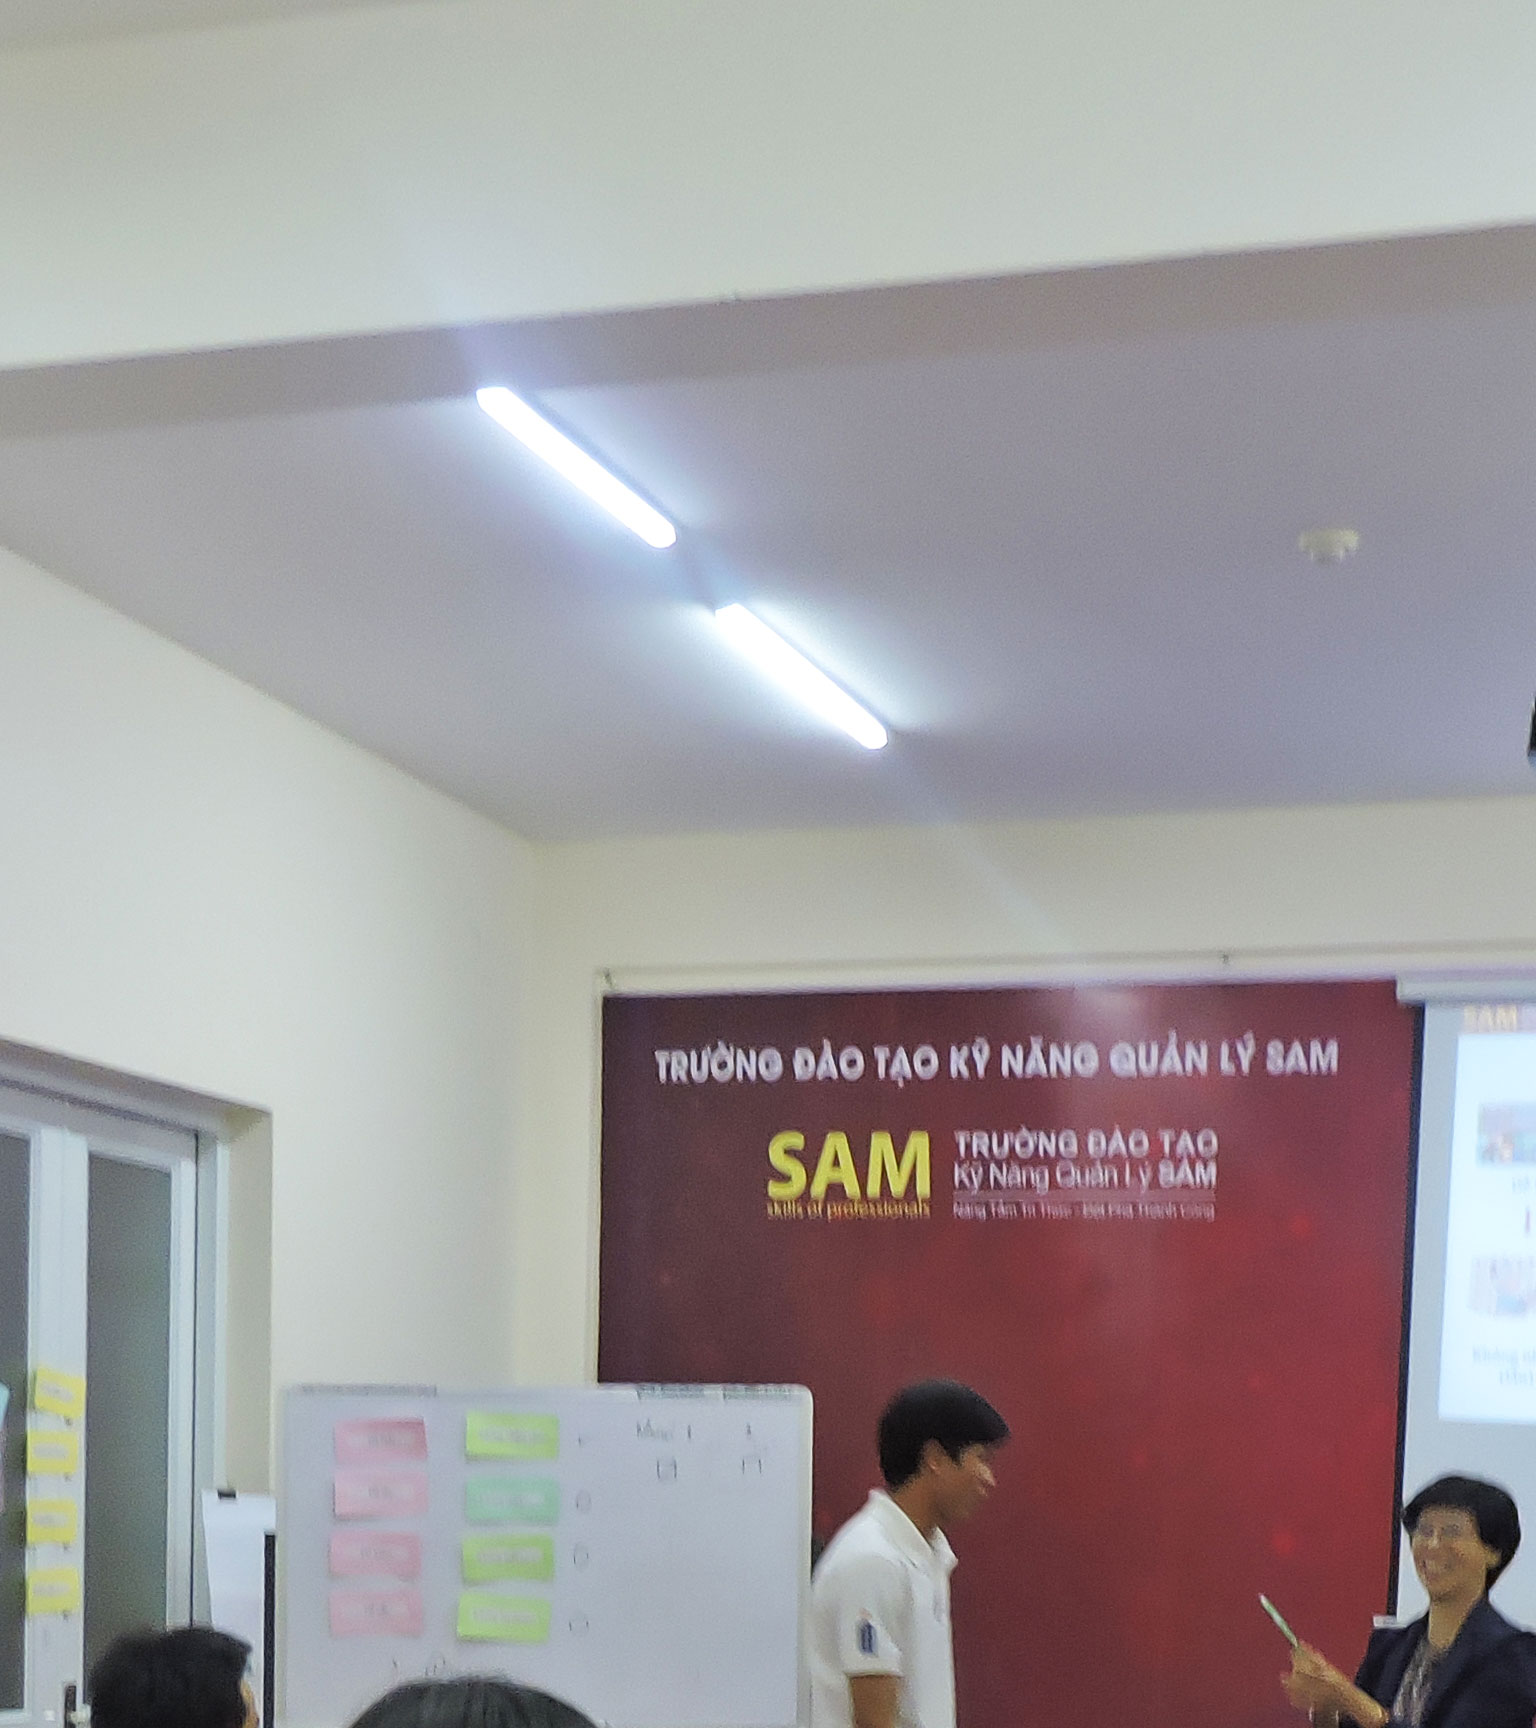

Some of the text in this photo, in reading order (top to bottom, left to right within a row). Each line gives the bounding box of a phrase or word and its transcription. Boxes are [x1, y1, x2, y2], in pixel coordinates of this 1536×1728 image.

[654, 1039, 784, 1083] TRƯỜNG
[874, 1044, 940, 1088] TẠO
[1220, 1031, 1256, 1077] LÝ
[1266, 1038, 1339, 1077] SAM
[953, 1125, 1078, 1159] TRƯỜNG
[767, 1130, 932, 1200] SAM
[1158, 1158, 1217, 1190] SAM
